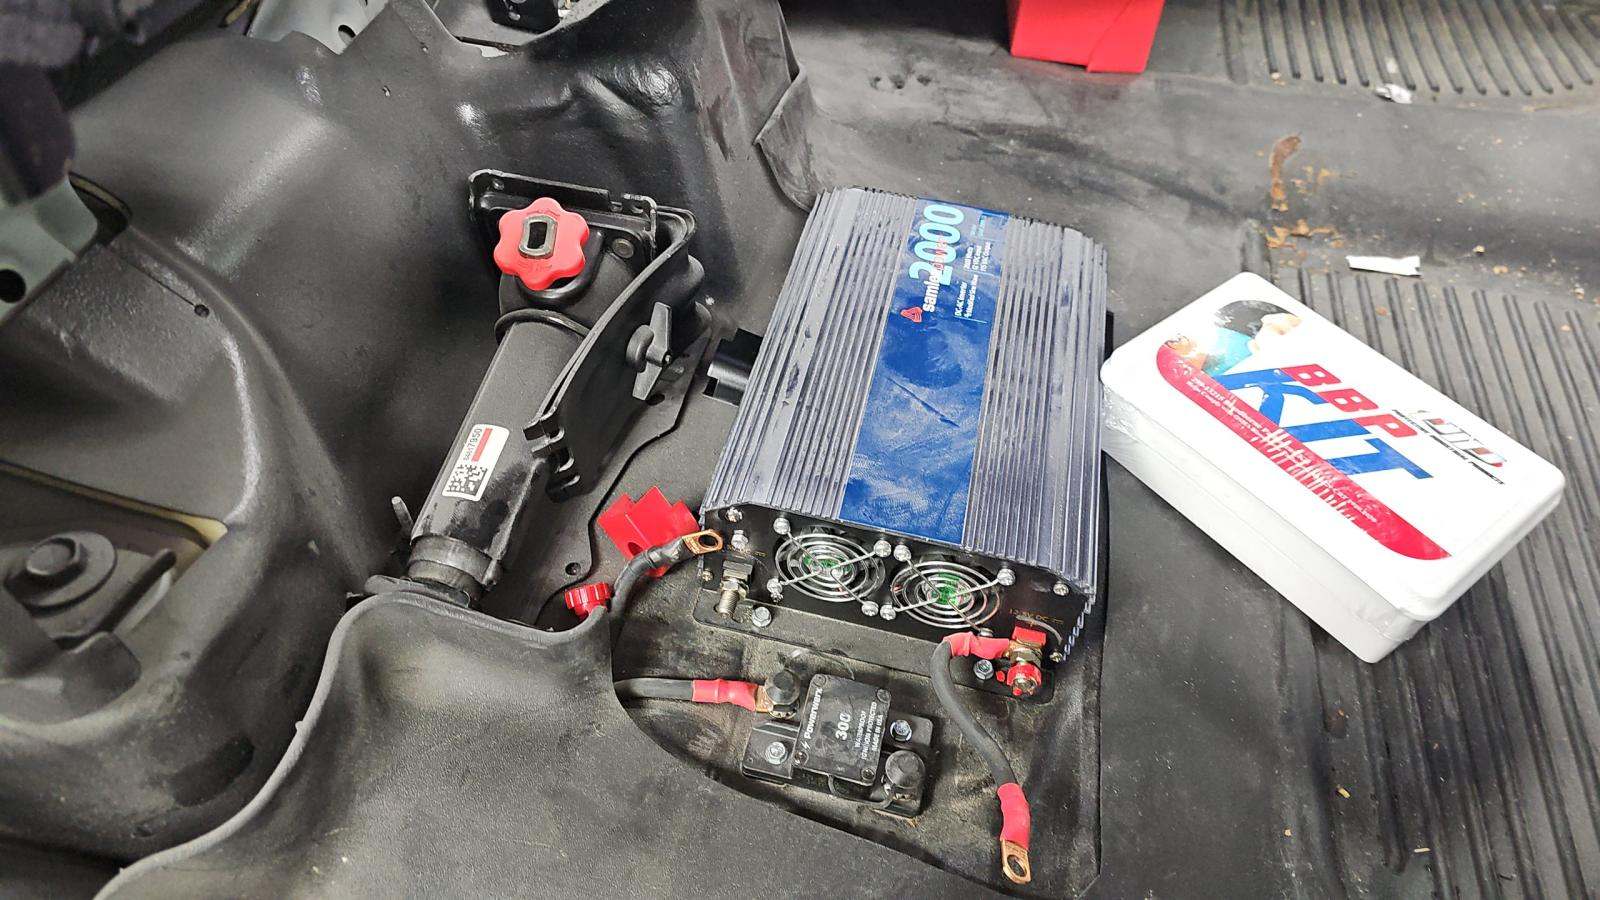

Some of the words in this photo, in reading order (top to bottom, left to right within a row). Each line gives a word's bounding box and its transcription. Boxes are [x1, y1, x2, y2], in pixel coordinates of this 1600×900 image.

[909, 204, 965, 285] 2000
[1211, 367, 1434, 480] KIT
[1280, 364, 1418, 438] BBP
[803, 687, 823, 740] Powerwerx
[834, 712, 851, 741] 300
